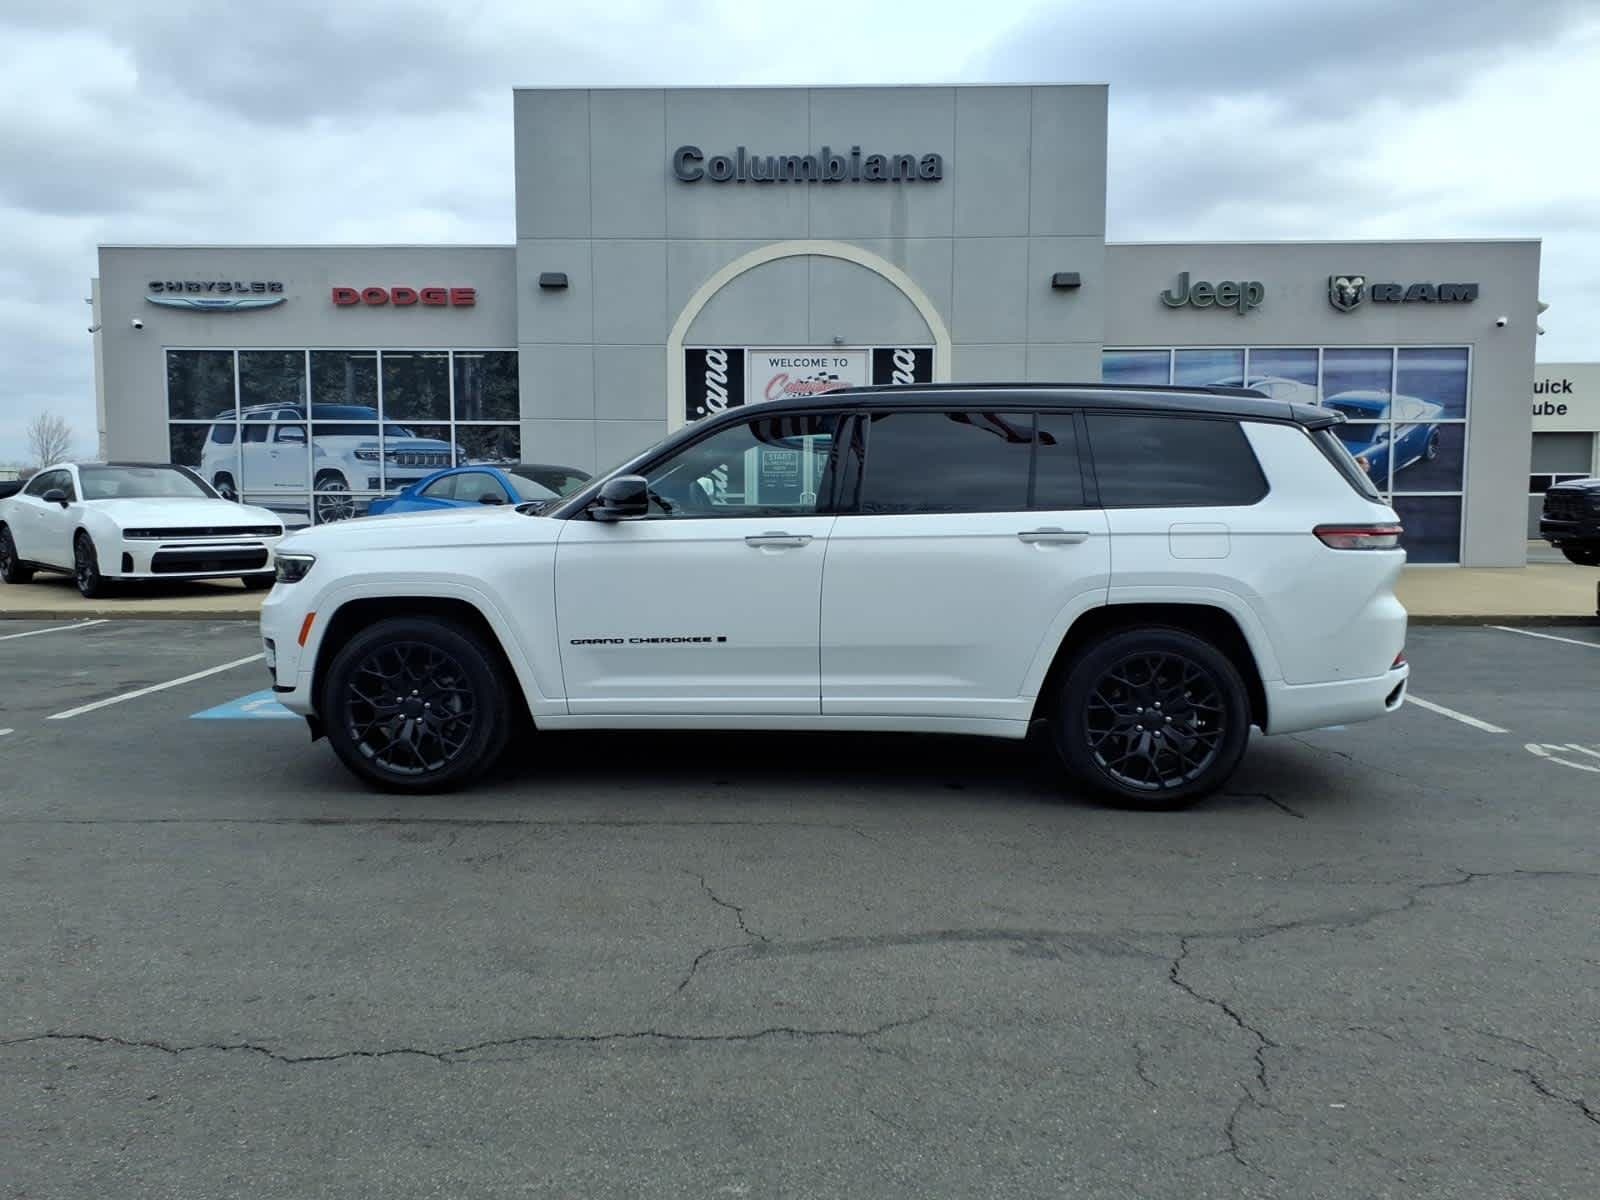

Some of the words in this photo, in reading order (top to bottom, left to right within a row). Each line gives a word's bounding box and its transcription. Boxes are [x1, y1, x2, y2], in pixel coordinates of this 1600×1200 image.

[673, 145, 943, 183] Columbiana
[148, 280, 283, 293] CHRYSLER
[1161, 271, 1265, 314] Jeep
[1371, 282, 1480, 303] RAM
[332, 287, 476, 305] DODGE
[769, 358, 828, 368] WELCOME
[833, 358, 849, 368] TO
[697, 349, 728, 416] ana
[1533, 379, 1573, 394] uick
[1532, 401, 1568, 416] ube
[570, 637, 624, 645] GRAND
[628, 636, 713, 644] CHEROKEE
